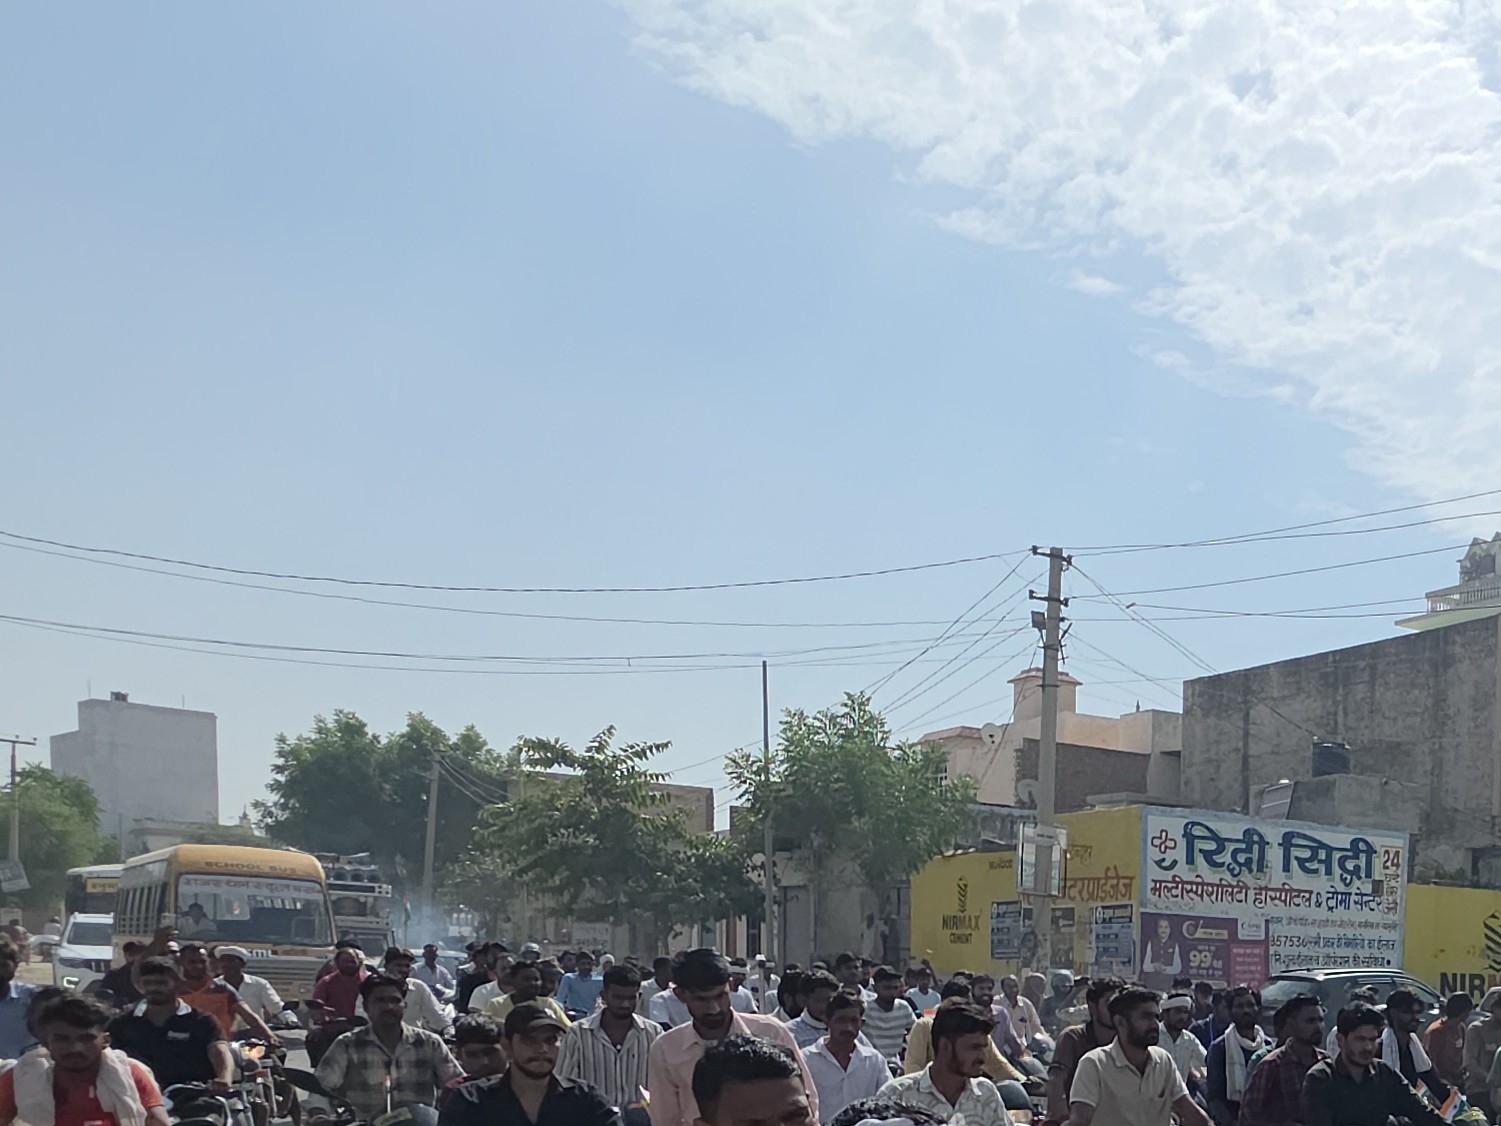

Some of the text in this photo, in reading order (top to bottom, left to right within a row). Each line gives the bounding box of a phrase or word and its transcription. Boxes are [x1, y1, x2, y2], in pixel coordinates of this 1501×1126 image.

[204, 861, 297, 873] SCHOOL BUS
[1383, 849, 1400, 870] 24
[1063, 865, 1136, 902] टरप्राईजेज
[1315, 892, 1323, 908] &
[942, 914, 980, 931] NIRMAX
